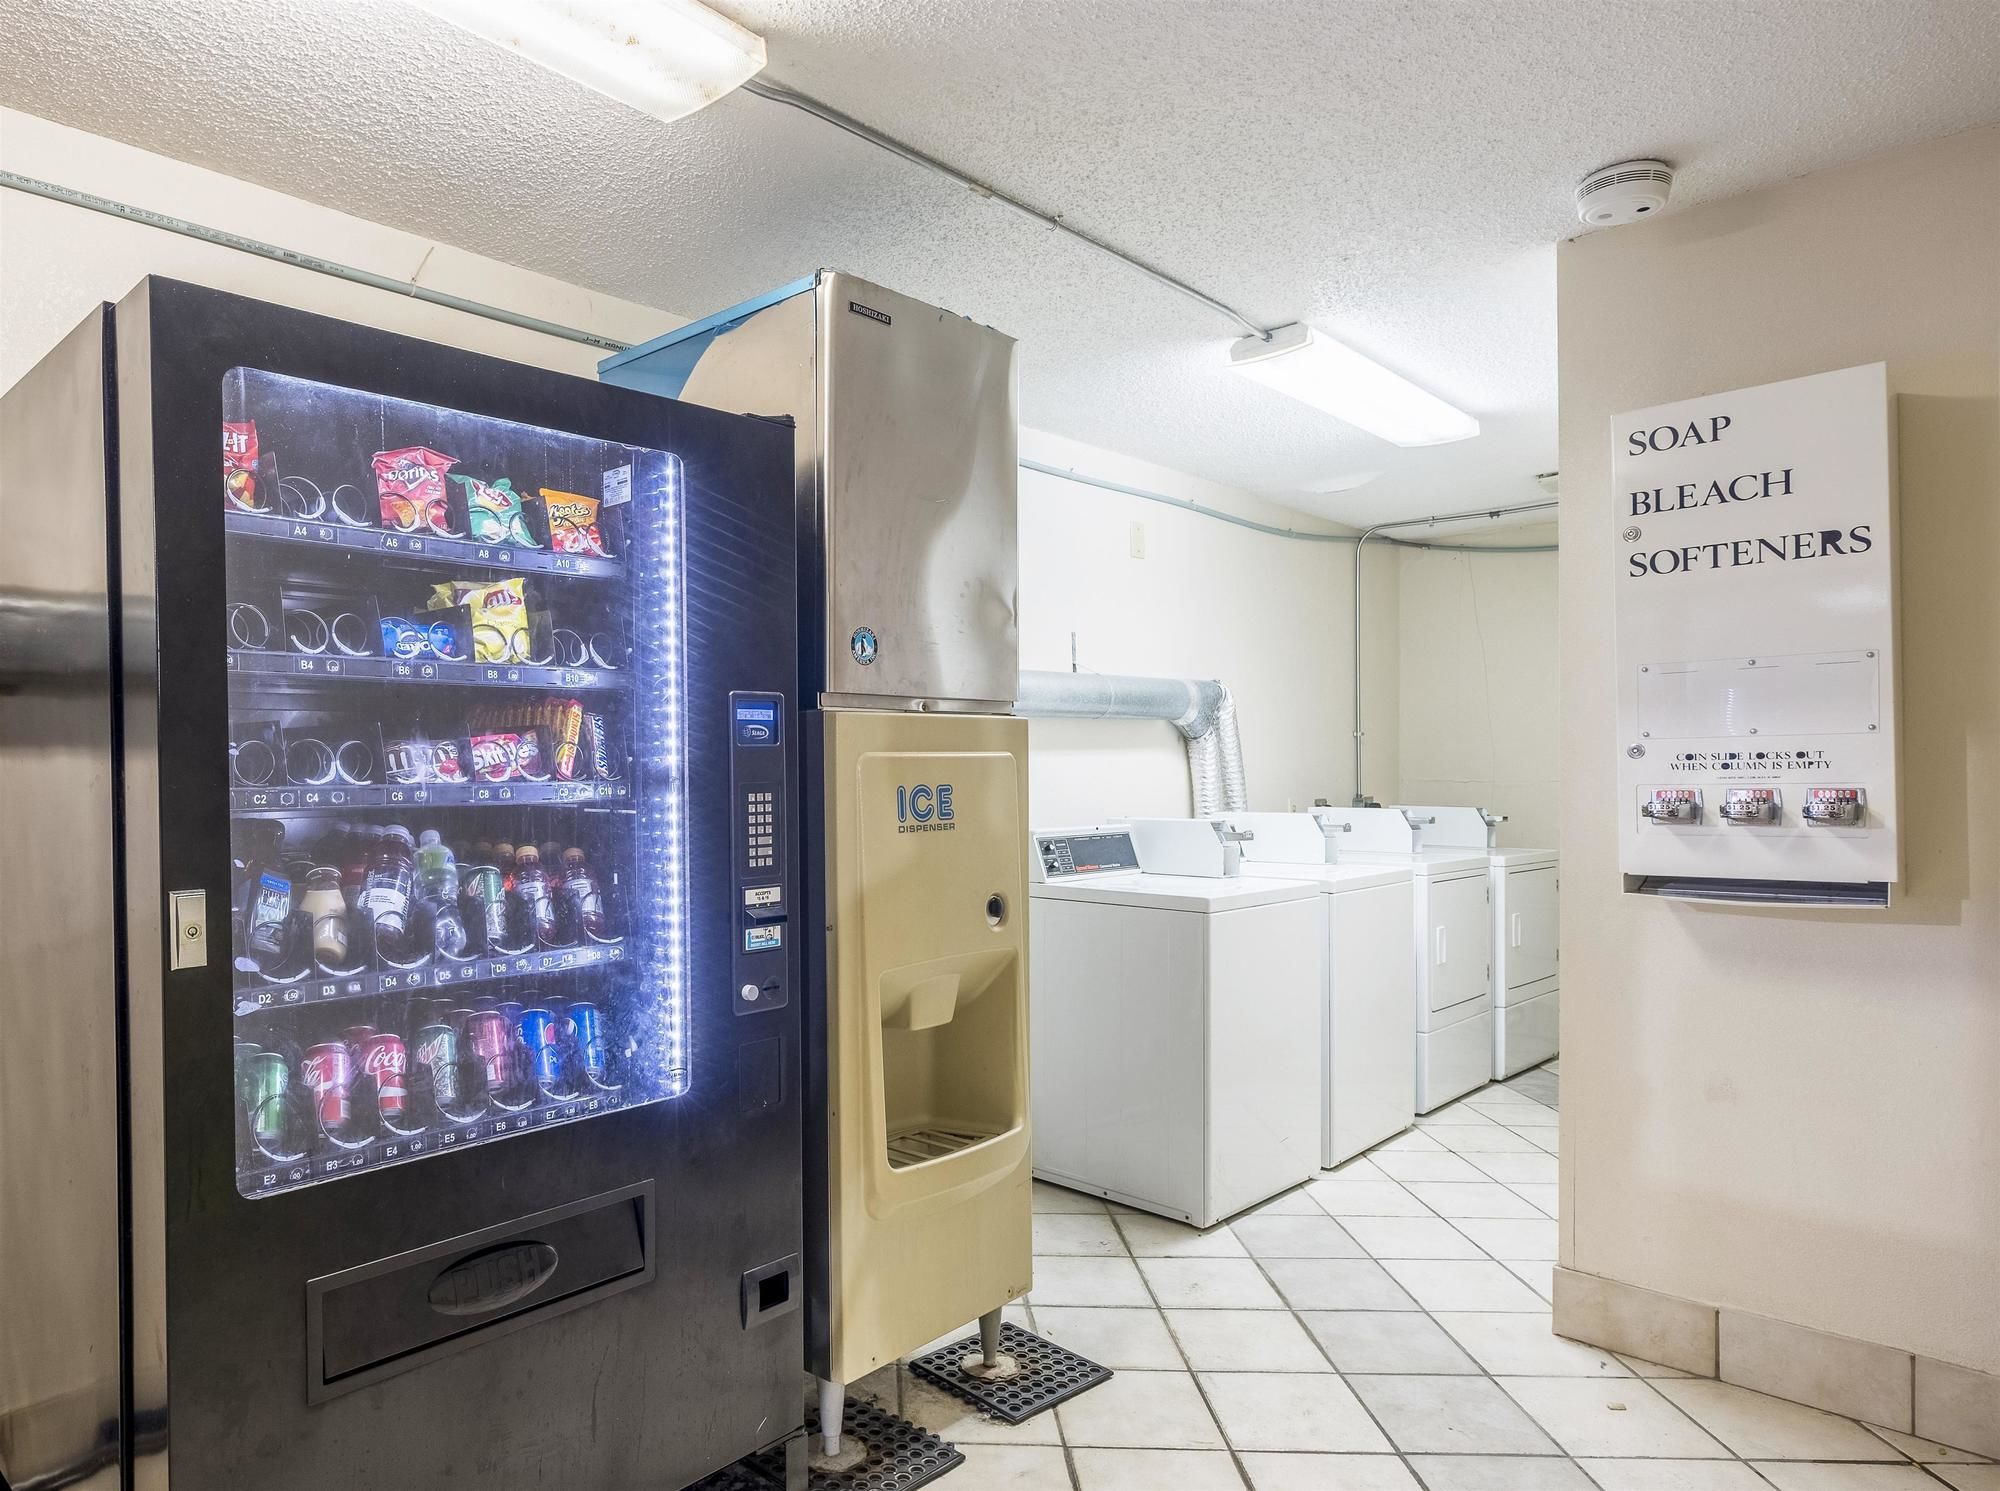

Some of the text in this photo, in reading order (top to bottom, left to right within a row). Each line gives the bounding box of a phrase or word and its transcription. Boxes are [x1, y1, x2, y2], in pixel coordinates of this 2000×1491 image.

[853, 303, 889, 323] HOSHIZAKI
[583, 336, 601, 344] J-M
[1629, 415, 1731, 456] SOAP
[1629, 468, 1794, 517] BLEACH
[294, 525, 307, 536] A4
[386, 537, 398, 547] A6
[478, 549, 490, 559] A8
[1629, 525, 1872, 578] SOFTENERS
[556, 559, 570, 568] A10
[301, 660, 314, 670] B4
[399, 665, 410, 675] B6
[487, 669, 498, 679] B8
[1676, 750, 1825, 762] COIN SLIDE LOCKS OUT
[1670, 759, 1833, 771] WHEN COLUMN IS EMPTY
[253, 794, 267, 804] C2
[306, 793, 319, 803] C4
[391, 791, 404, 801] C6
[479, 789, 490, 799] C8
[897, 784, 954, 823] ICE
[898, 823, 956, 833] DISPENSER
[543, 957, 553, 966] D7
[496, 963, 507, 973] D6
[439, 971, 451, 981] D5
[385, 976, 397, 987] D4
[322, 985, 336, 996] D3
[258, 993, 272, 1004] D2
[589, 1099, 599, 1110] E8
[546, 1110, 556, 1120] E7
[496, 1122, 507, 1132] E6
[444, 1133, 455, 1144] E5
[387, 1146, 398, 1157] E4
[352, 1157, 364, 1166] 1.00
[264, 1173, 276, 1185] E2
[451, 1246, 539, 1309] PUSH
